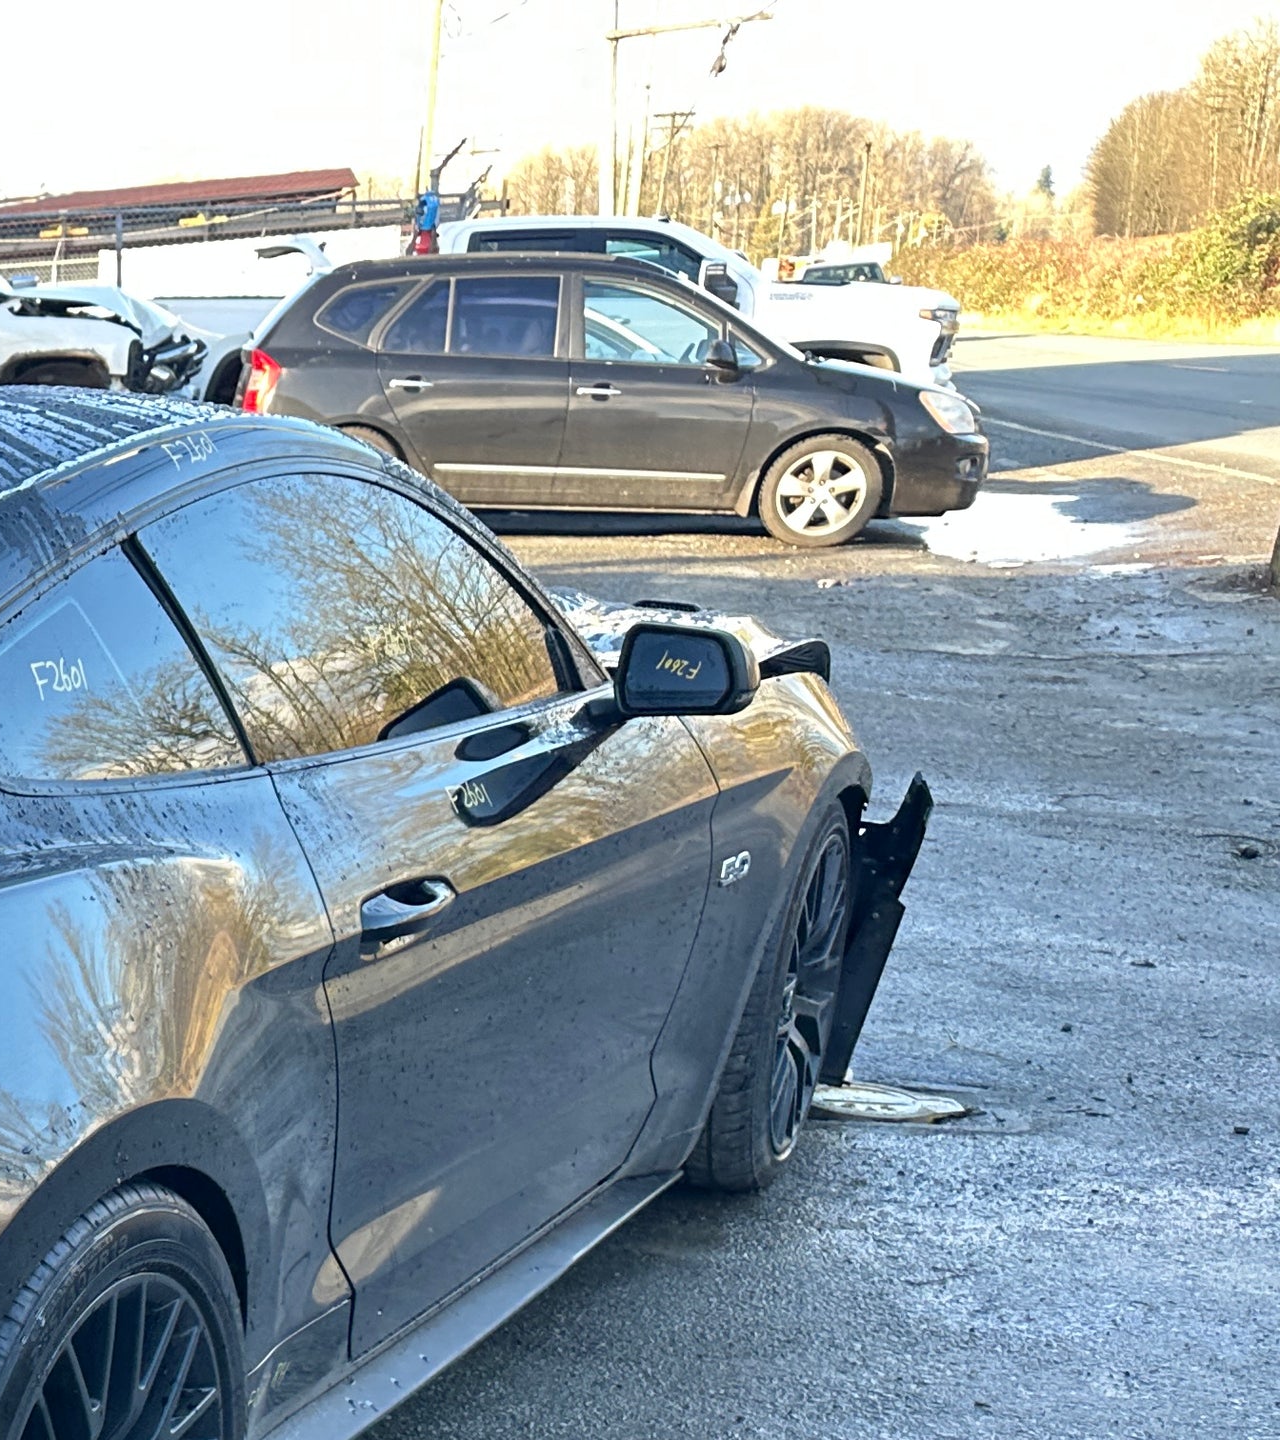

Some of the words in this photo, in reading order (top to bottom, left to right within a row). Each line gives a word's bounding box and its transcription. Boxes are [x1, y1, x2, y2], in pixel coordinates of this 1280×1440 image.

[161, 430, 219, 472] F2601
[30, 657, 89, 701] F2601
[655, 649, 702, 680] F2601
[445, 781, 493, 814] F2601
